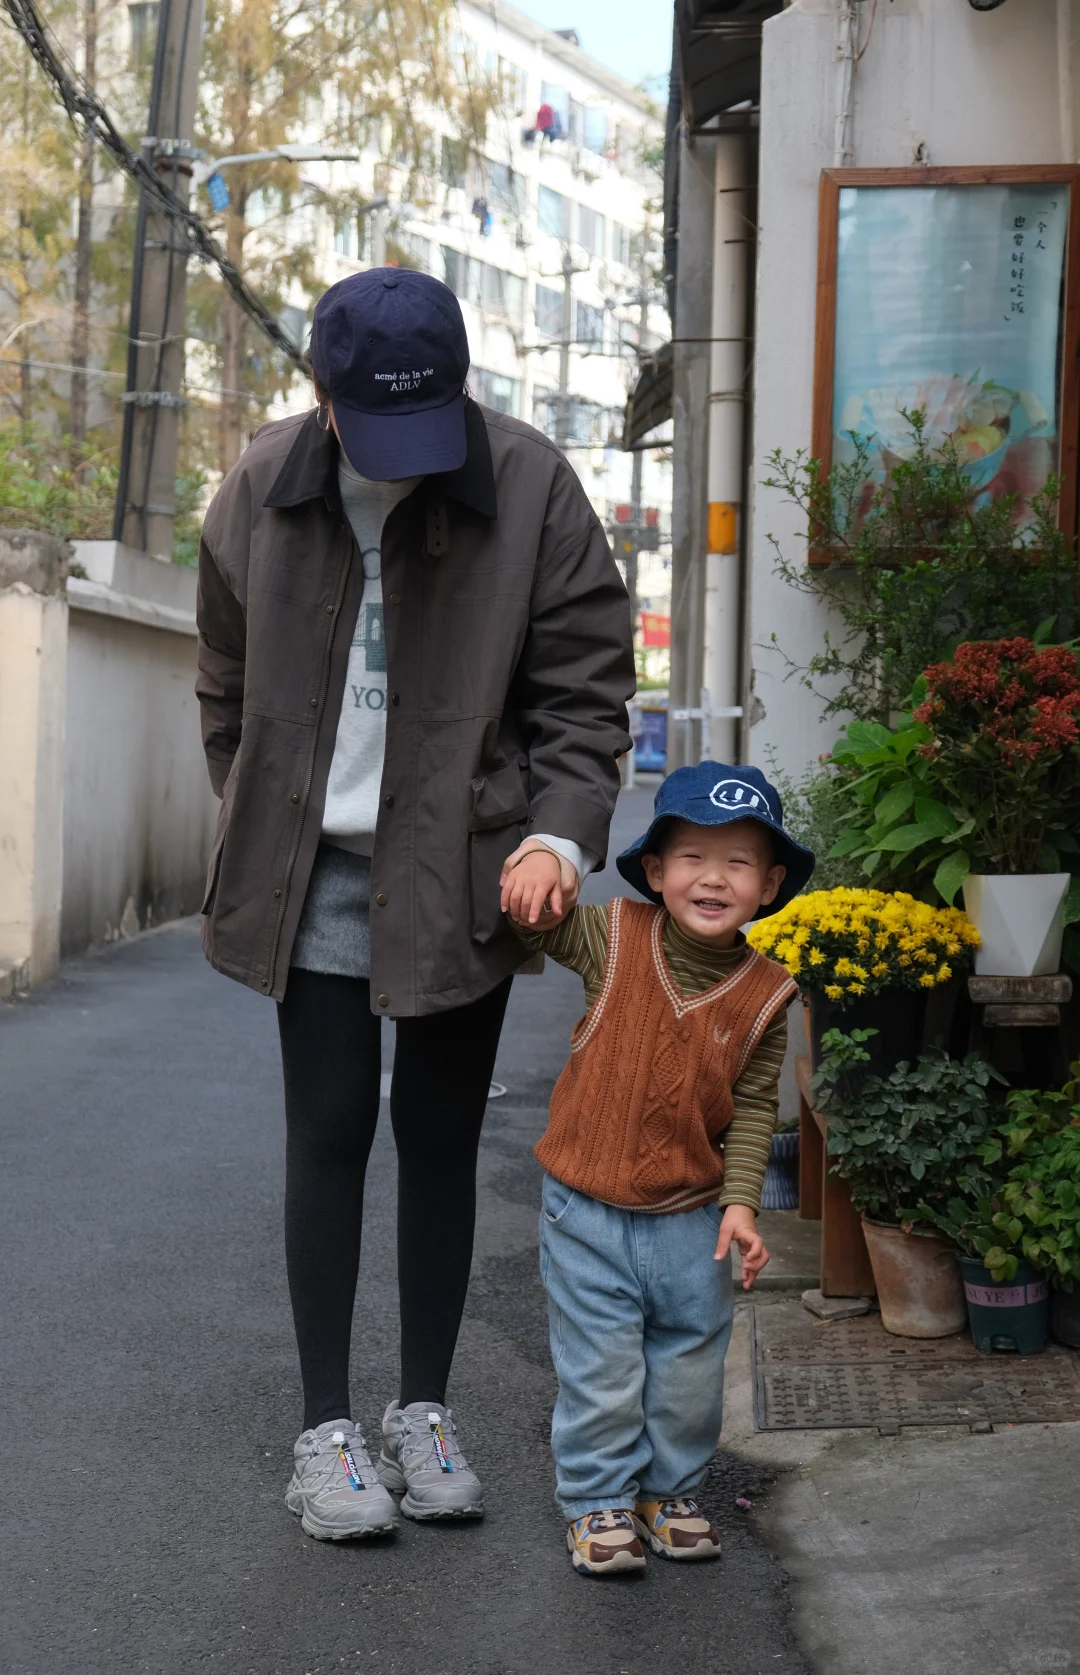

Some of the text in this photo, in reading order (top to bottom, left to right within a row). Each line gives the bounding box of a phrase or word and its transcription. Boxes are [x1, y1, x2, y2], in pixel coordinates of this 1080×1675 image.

[374, 367, 434, 381] acmé de la vie
[390, 380, 421, 391] ADLV
[351, 685, 387, 711] YO
